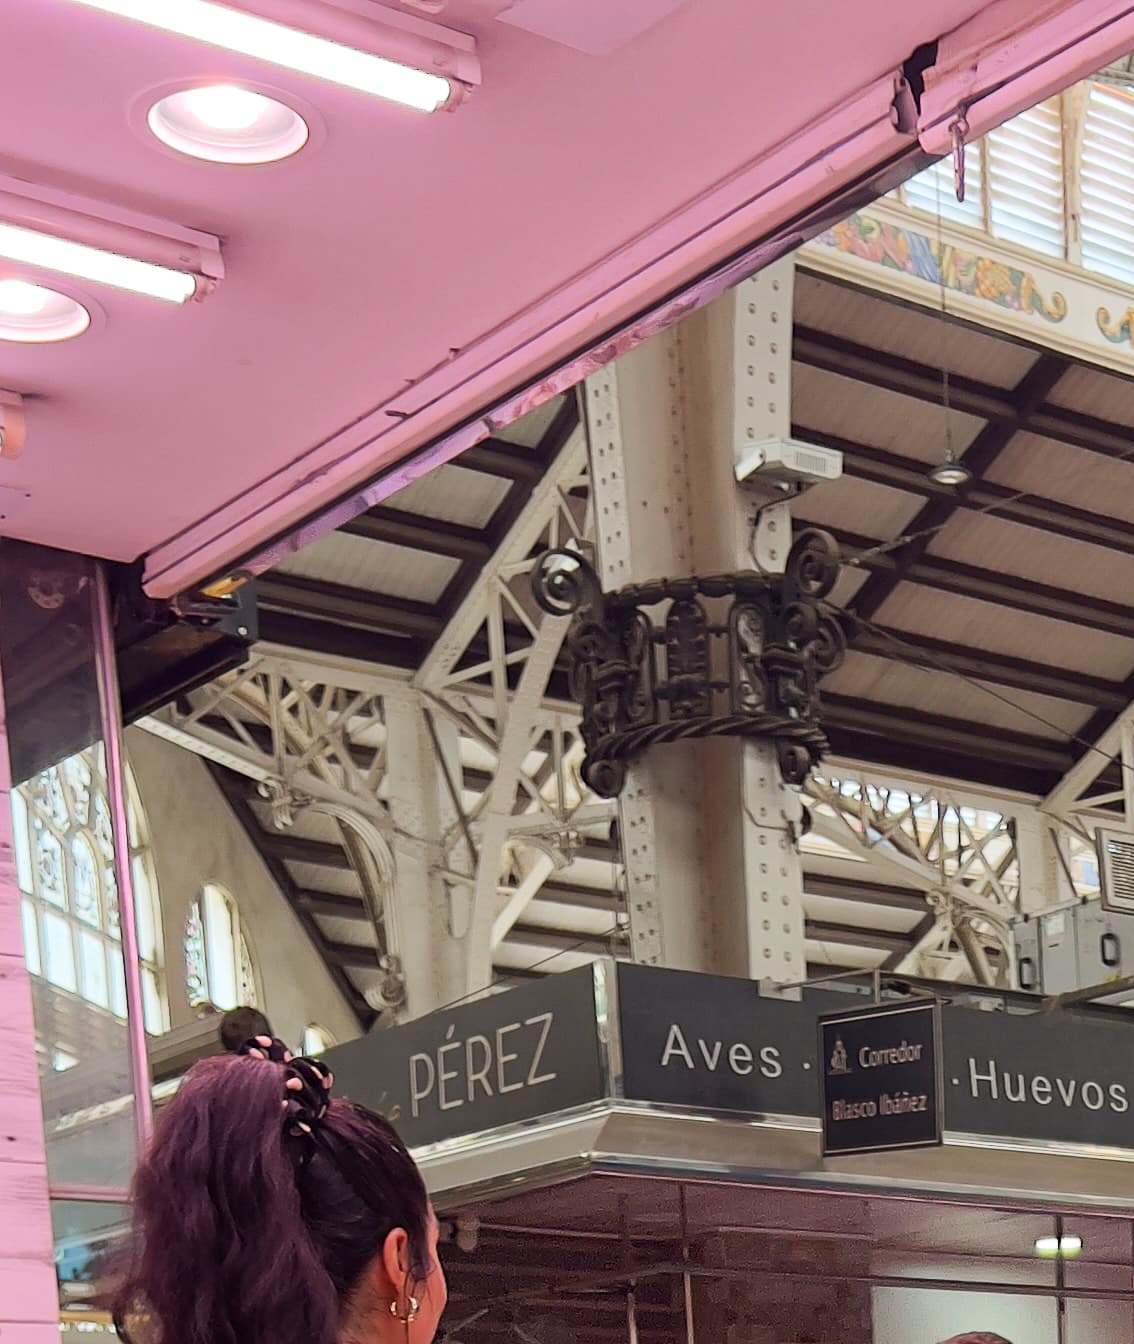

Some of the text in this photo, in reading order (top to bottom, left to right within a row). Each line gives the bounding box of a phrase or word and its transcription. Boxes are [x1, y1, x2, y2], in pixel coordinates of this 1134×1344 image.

[409, 1012, 556, 1118] PÉREZ
[661, 1024, 783, 1079] Aves
[858, 1040, 923, 1068] Corredor
[832, 1091, 928, 1120] Blasco Ibáñez
[968, 1057, 1129, 1114] Huevos
